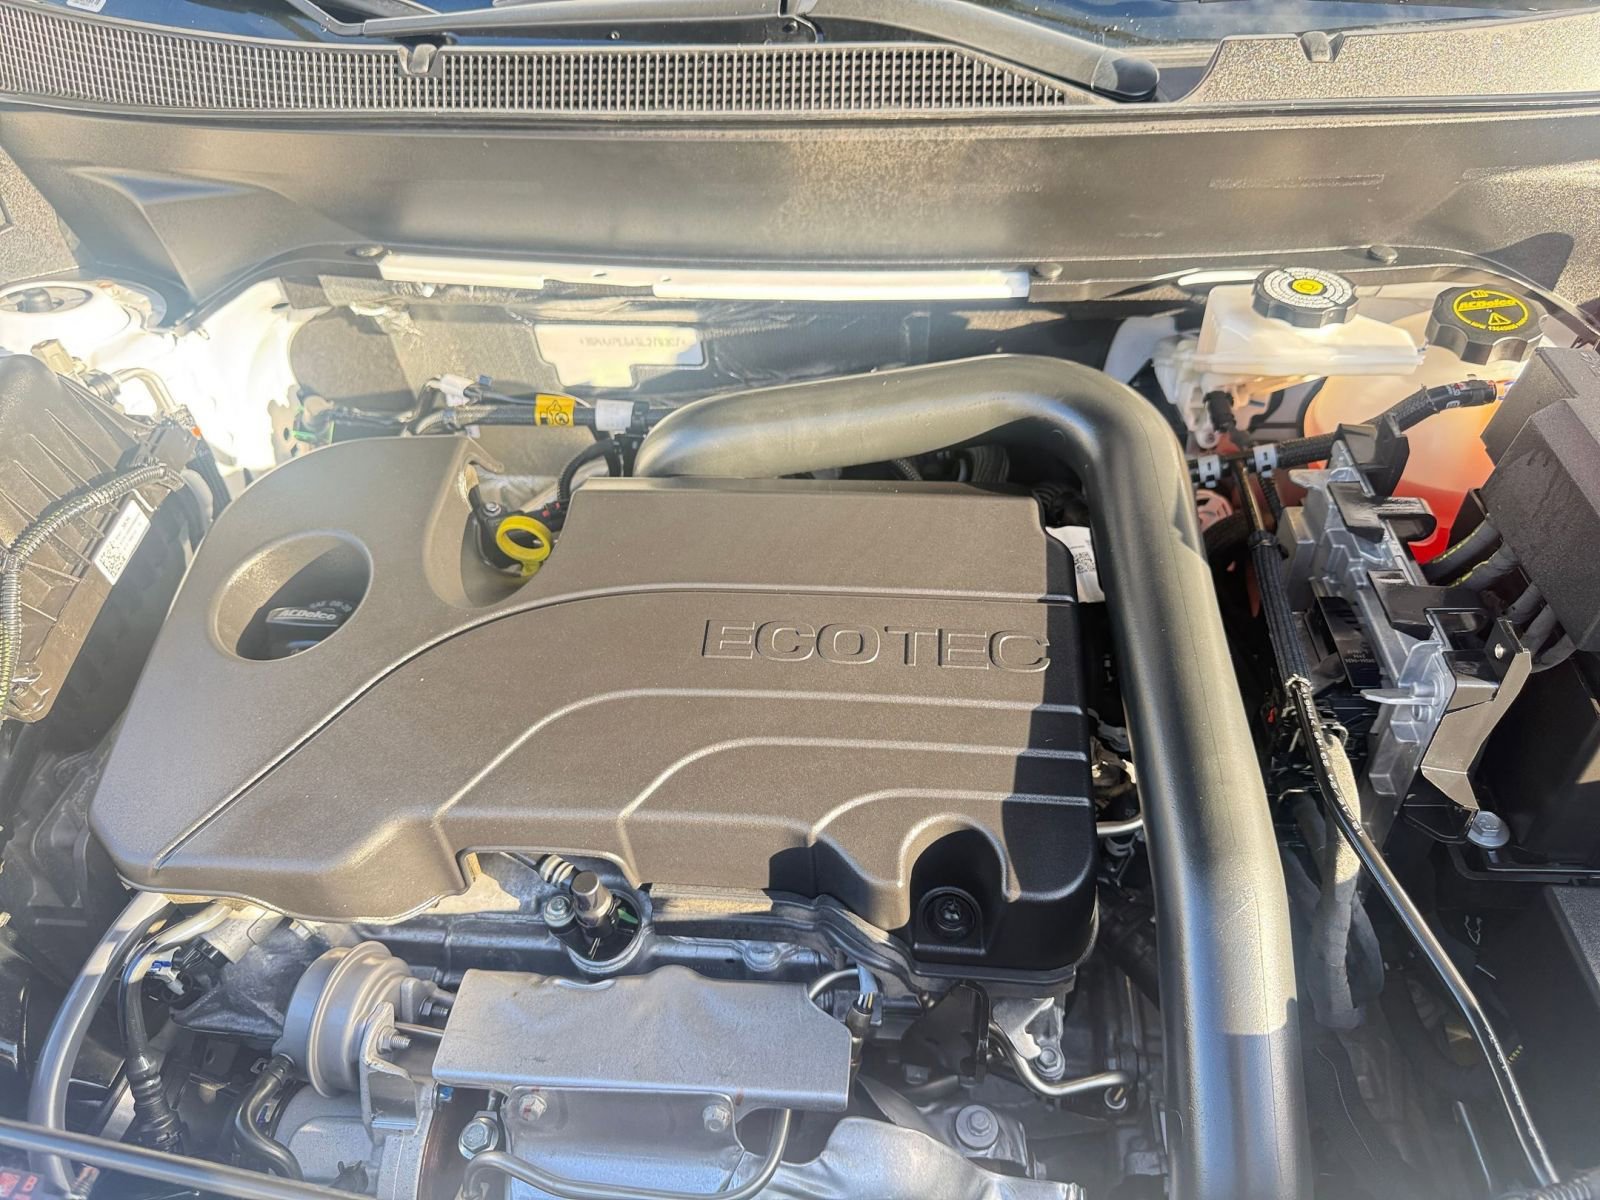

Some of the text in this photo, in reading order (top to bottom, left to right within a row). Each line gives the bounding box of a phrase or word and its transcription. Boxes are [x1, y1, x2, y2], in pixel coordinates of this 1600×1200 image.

[1458, 298, 1517, 311] ACDelco
[278, 609, 337, 621] ACDelco
[702, 620, 1050, 672] ECOTEC
